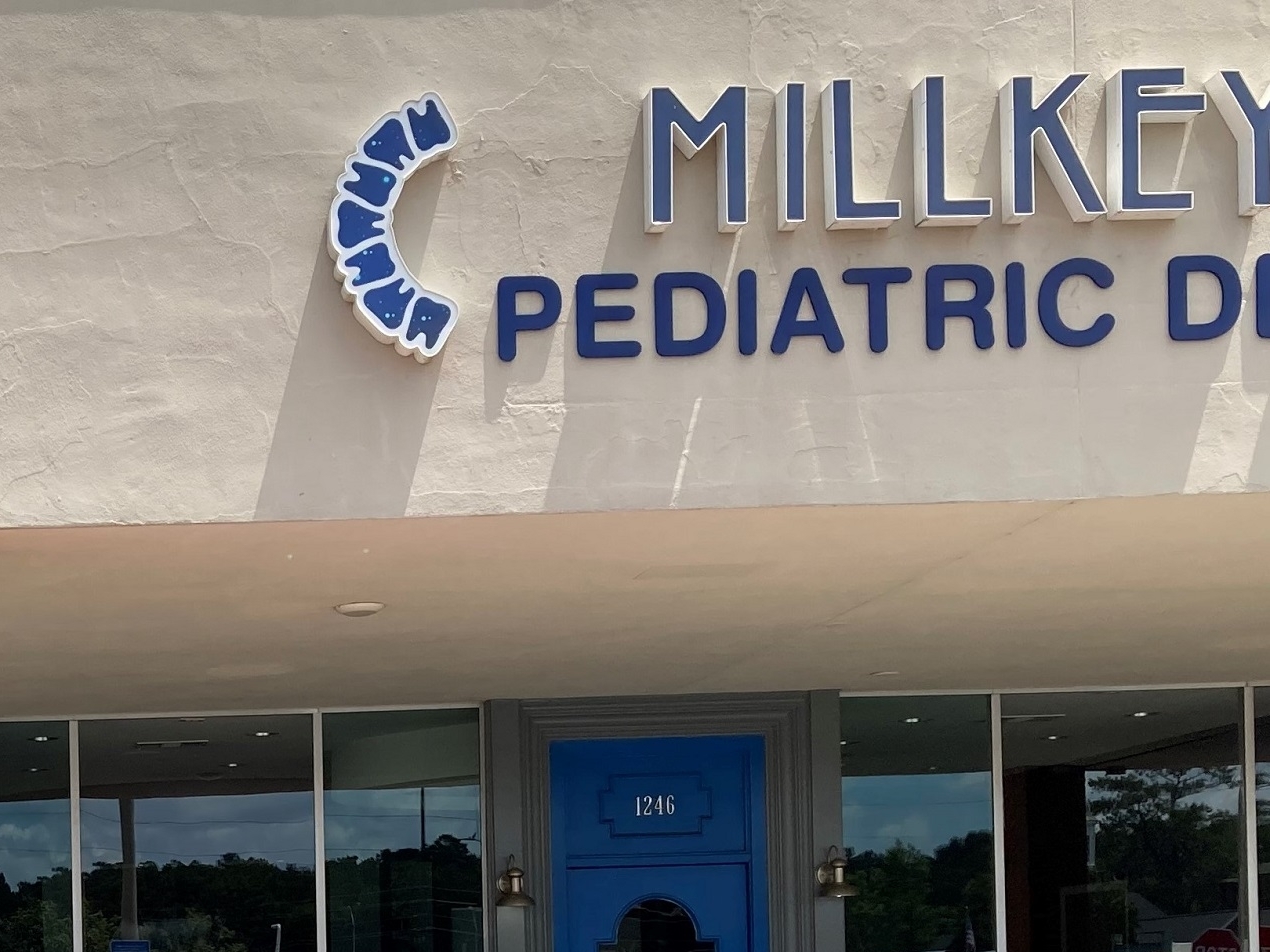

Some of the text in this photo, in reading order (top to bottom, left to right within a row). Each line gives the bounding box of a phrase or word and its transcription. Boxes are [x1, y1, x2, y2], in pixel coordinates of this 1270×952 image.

[496, 253, 1270, 363] PEDIATRIC D
[635, 794, 675, 817] 1246
